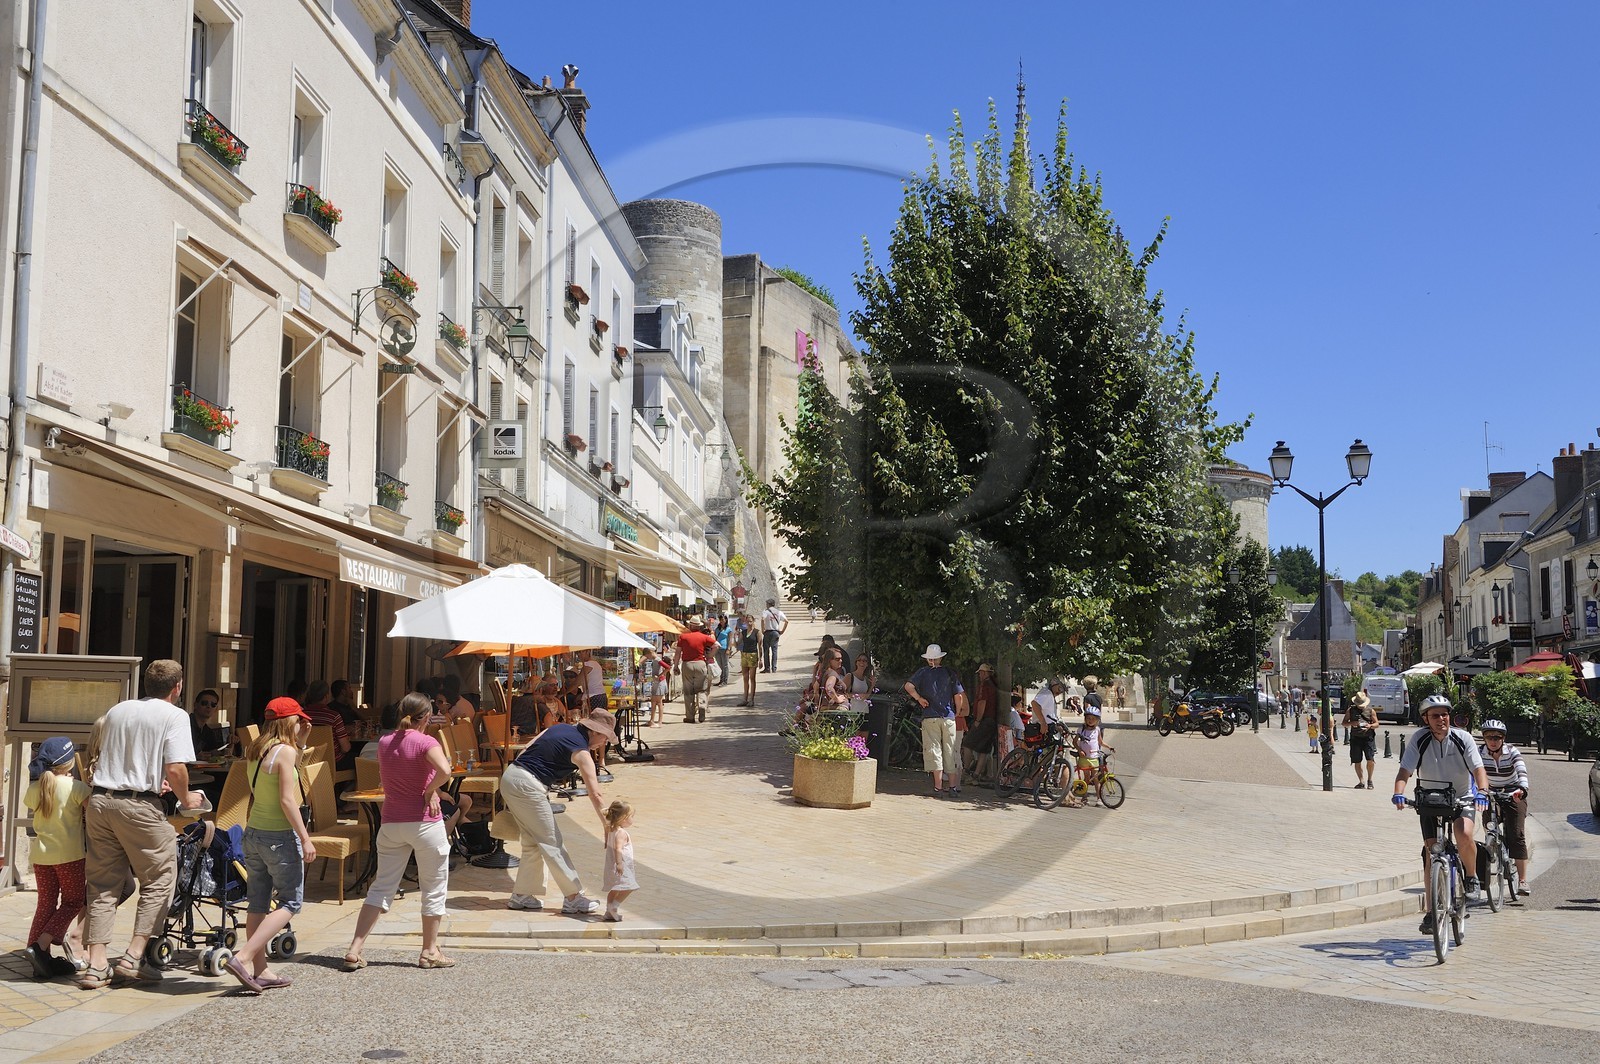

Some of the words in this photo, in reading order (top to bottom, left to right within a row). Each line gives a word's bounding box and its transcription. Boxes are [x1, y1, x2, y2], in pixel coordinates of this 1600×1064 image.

[346, 558, 407, 593] RESTAURANT
[17, 595, 35, 606] SALADES
[1563, 615, 1572, 639] TABAC
